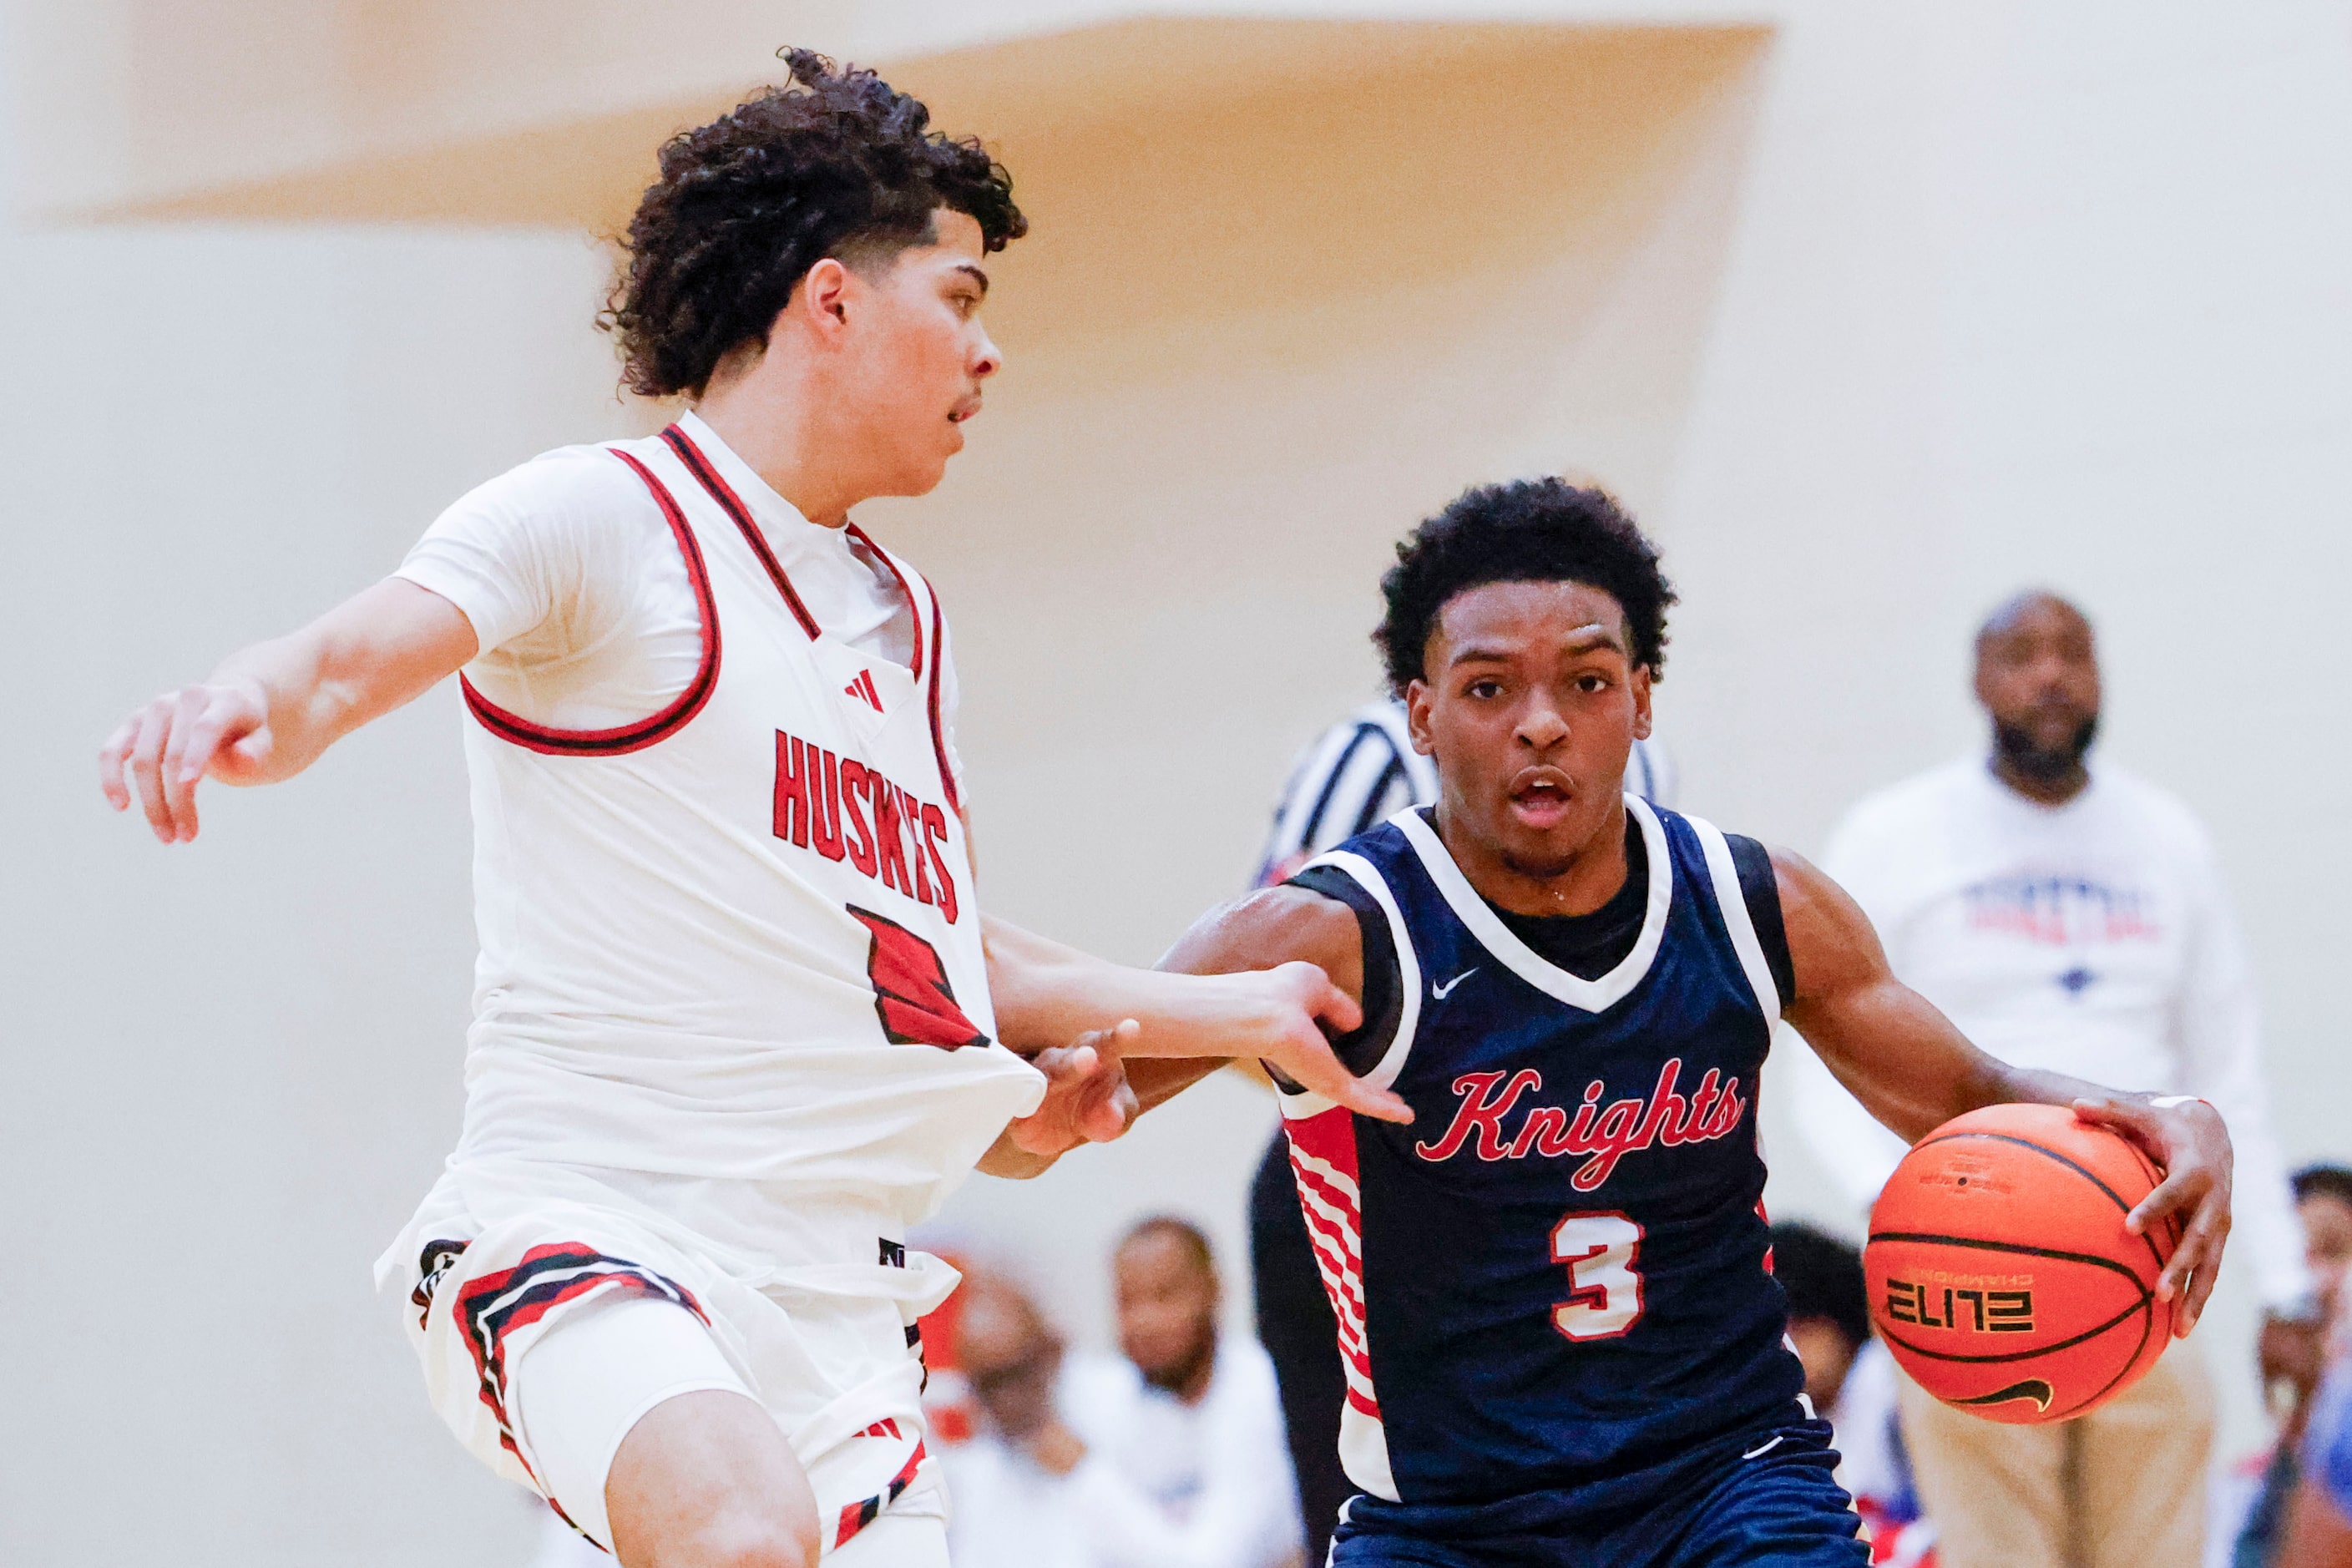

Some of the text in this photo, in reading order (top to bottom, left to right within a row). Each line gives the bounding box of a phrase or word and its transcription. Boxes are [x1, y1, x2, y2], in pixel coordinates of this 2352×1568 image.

[1415, 1057, 1747, 1192] Knights
[1549, 1209, 1646, 1343] 3
[1887, 1277, 2036, 1333] ELITE
